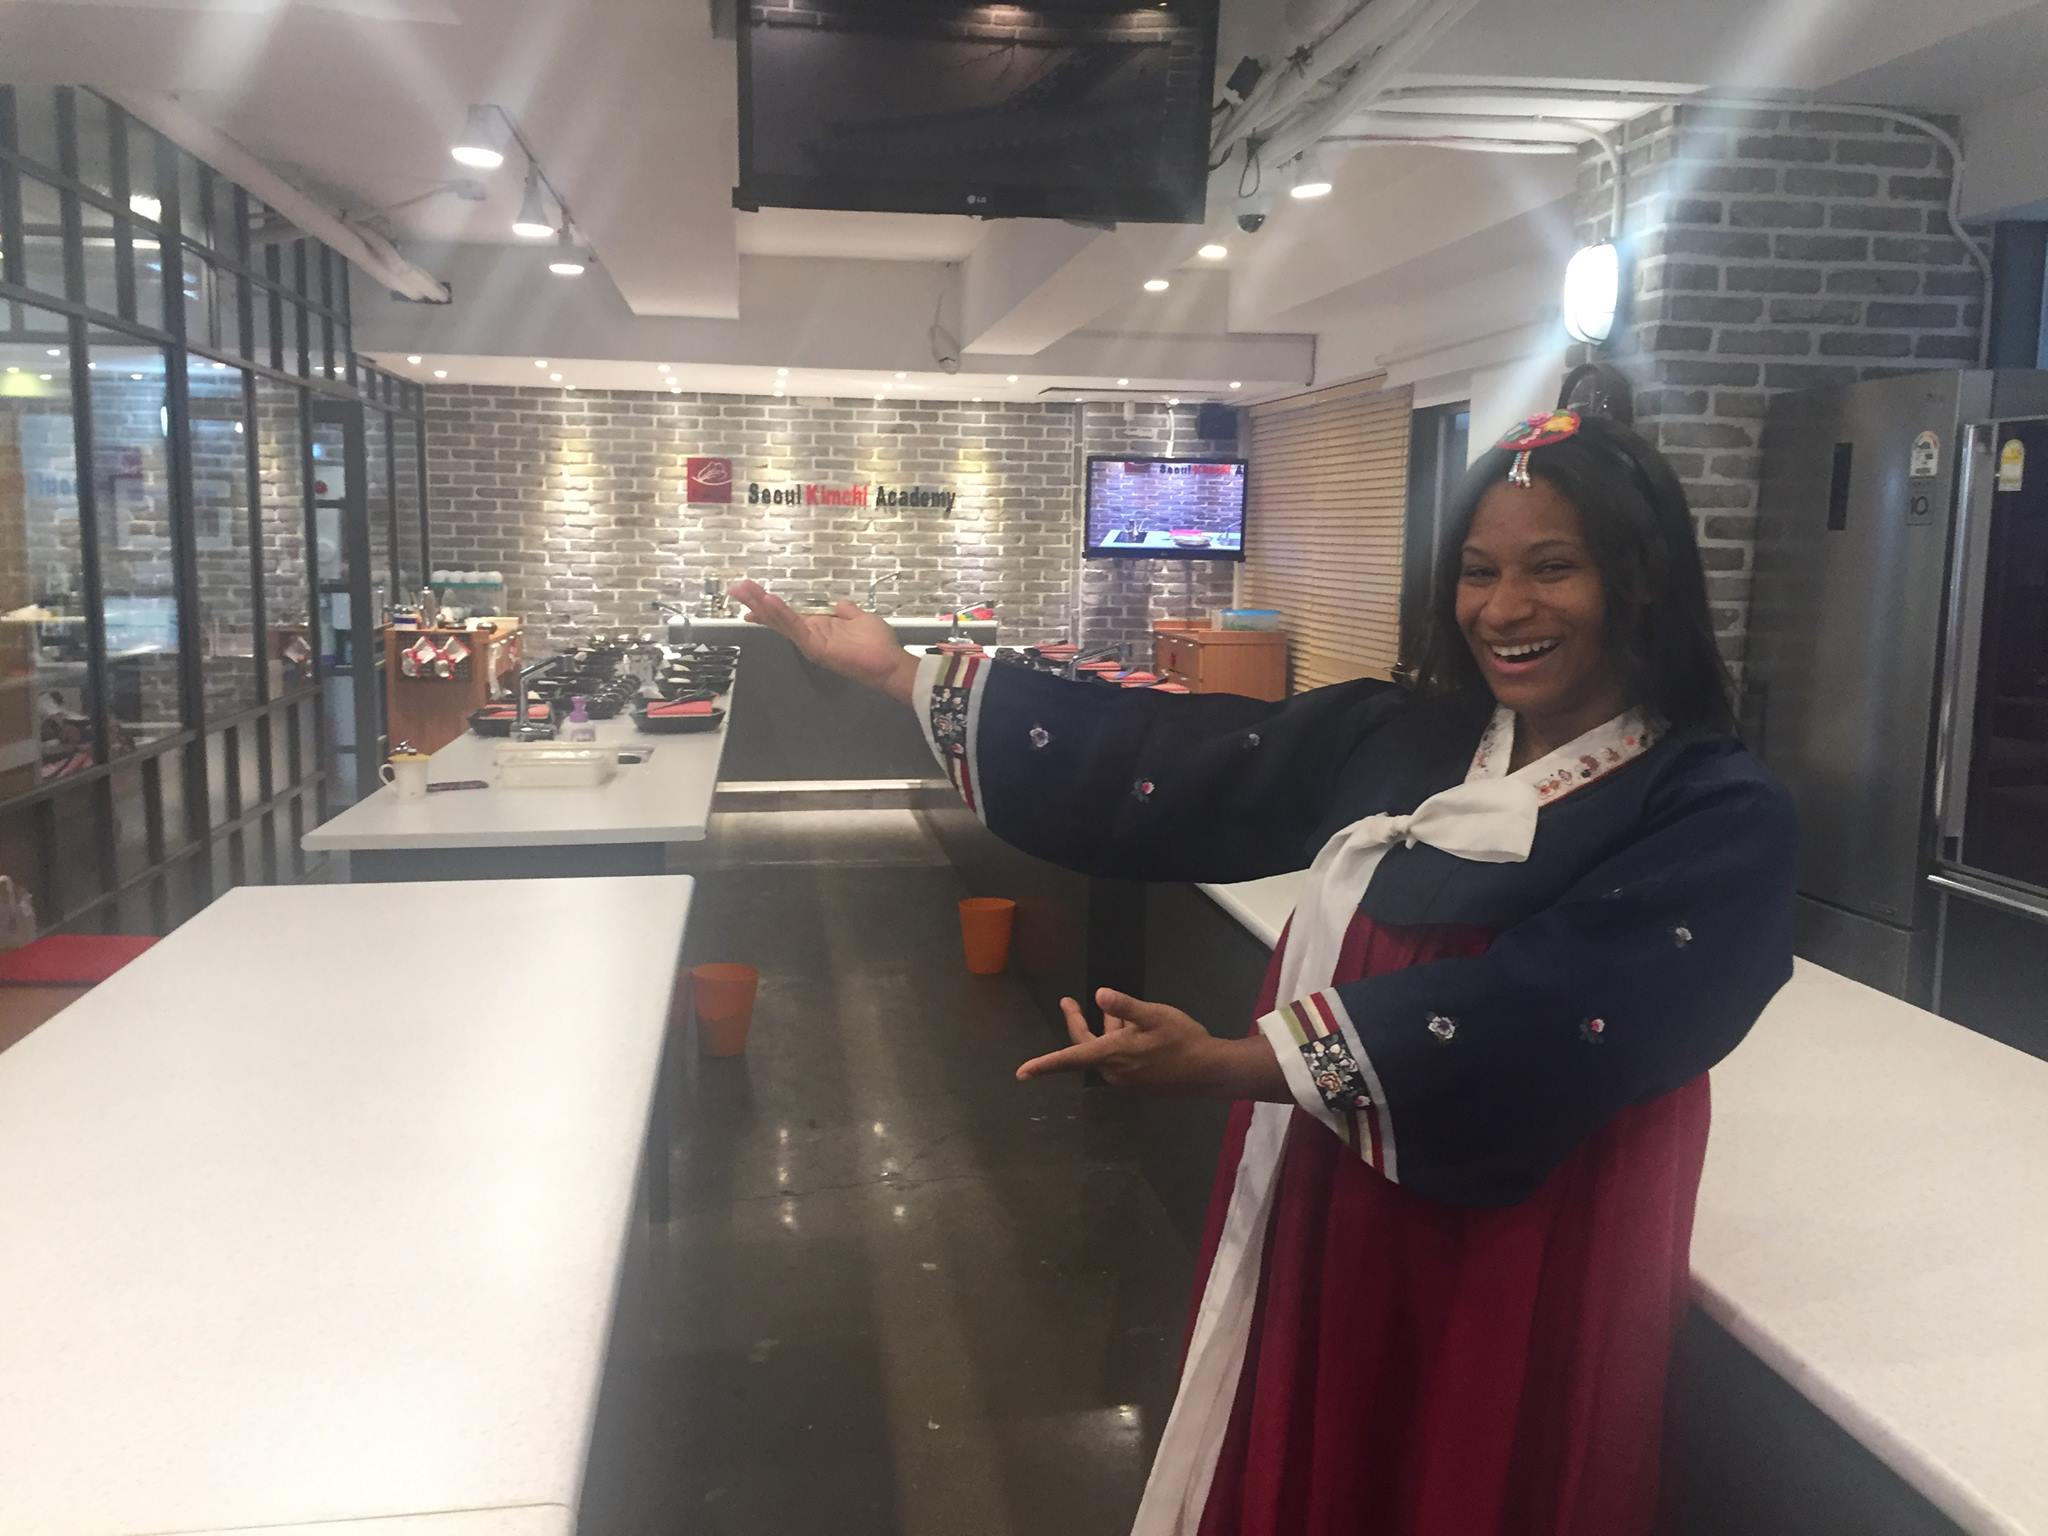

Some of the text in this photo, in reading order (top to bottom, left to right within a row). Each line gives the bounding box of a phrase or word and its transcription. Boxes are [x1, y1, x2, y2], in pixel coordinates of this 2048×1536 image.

[748, 483, 956, 513] Seoul Kimchi Academy
